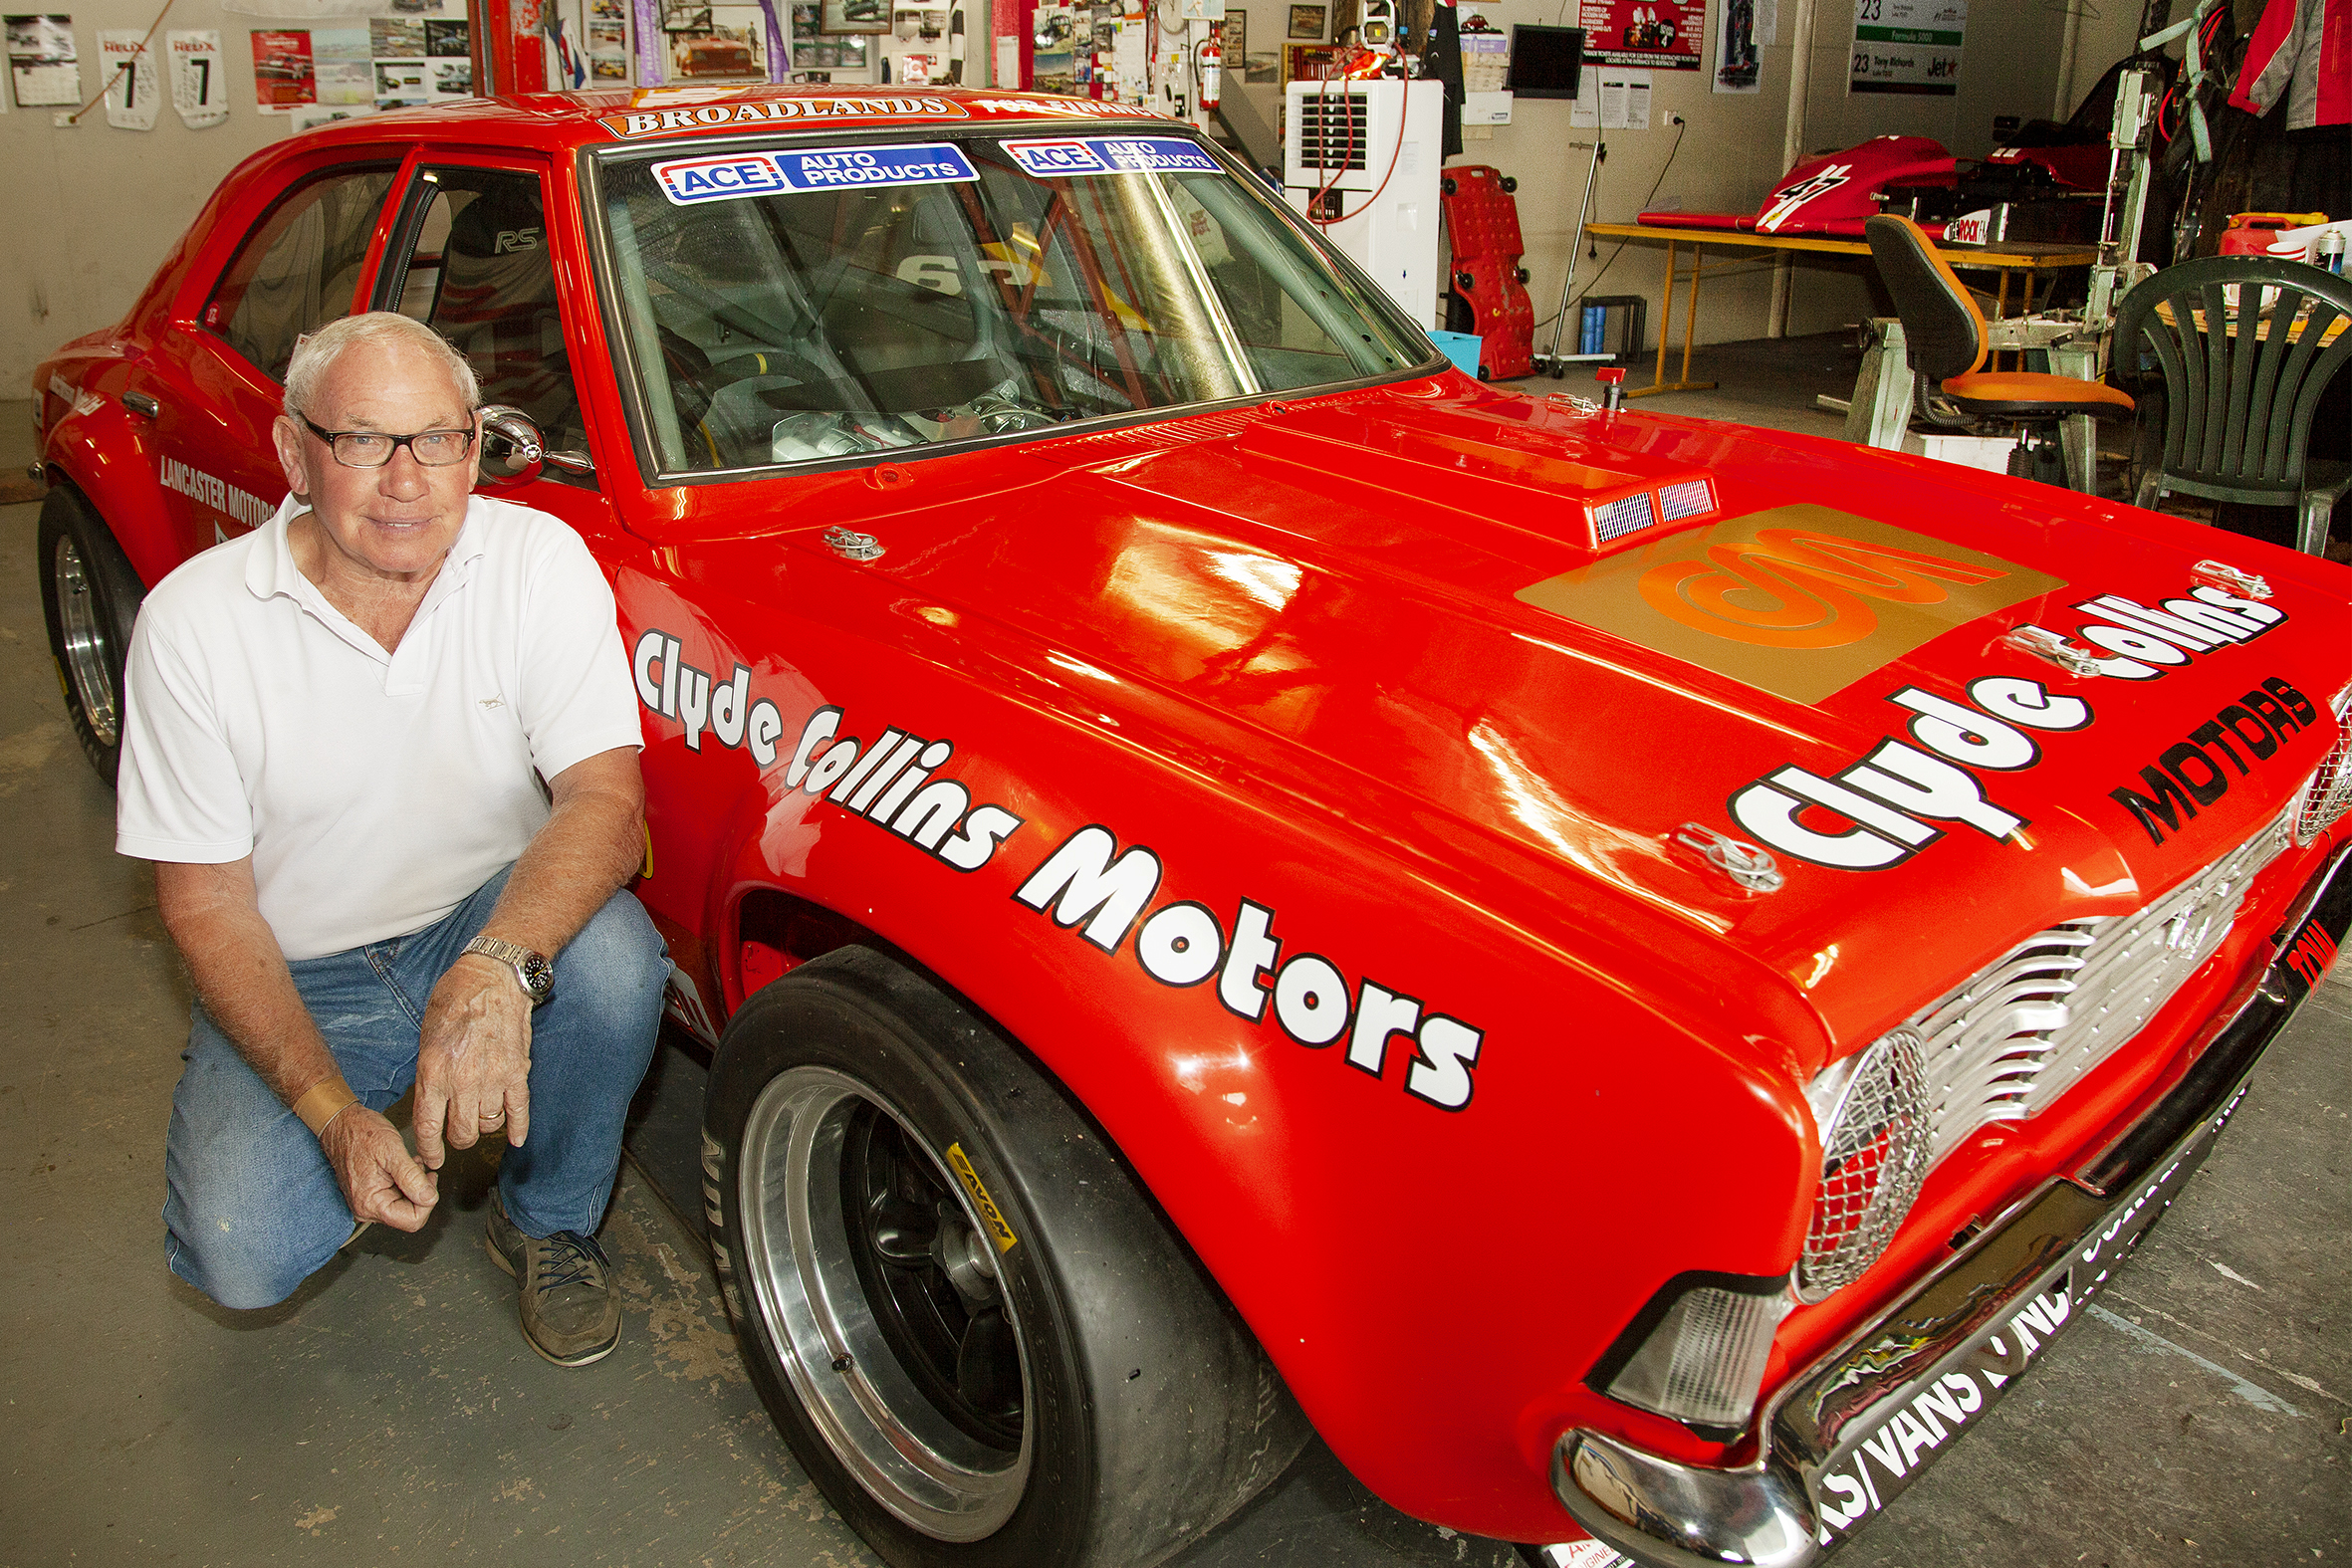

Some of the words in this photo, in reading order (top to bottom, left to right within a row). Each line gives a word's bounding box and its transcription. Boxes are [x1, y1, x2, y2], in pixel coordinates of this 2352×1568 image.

[1860, 0, 1882, 21] 23
[1854, 54, 1870, 74] 23
[623, 97, 952, 136] BROADLANDS
[800, 150, 879, 171] AUTO
[1027, 147, 1085, 168] ACE
[1102, 141, 1157, 156] AUTO
[1111, 153, 1212, 169] PRODUCTS
[683, 161, 763, 193] ACE
[803, 161, 960, 187] PRODUCTS
[494, 227, 540, 254] RS
[1958, 218, 1980, 242] ROCK
[159, 454, 227, 514] LANCASTER
[1727, 675, 2096, 871] Clyde
[2011, 585, 2290, 681] Collins
[2108, 676, 2318, 847] MOTORS
[633, 627, 784, 770] Clyde
[784, 704, 1027, 874] Collins
[1010, 822, 1486, 1113] Motors
[963, 1172, 1012, 1240] AVON
